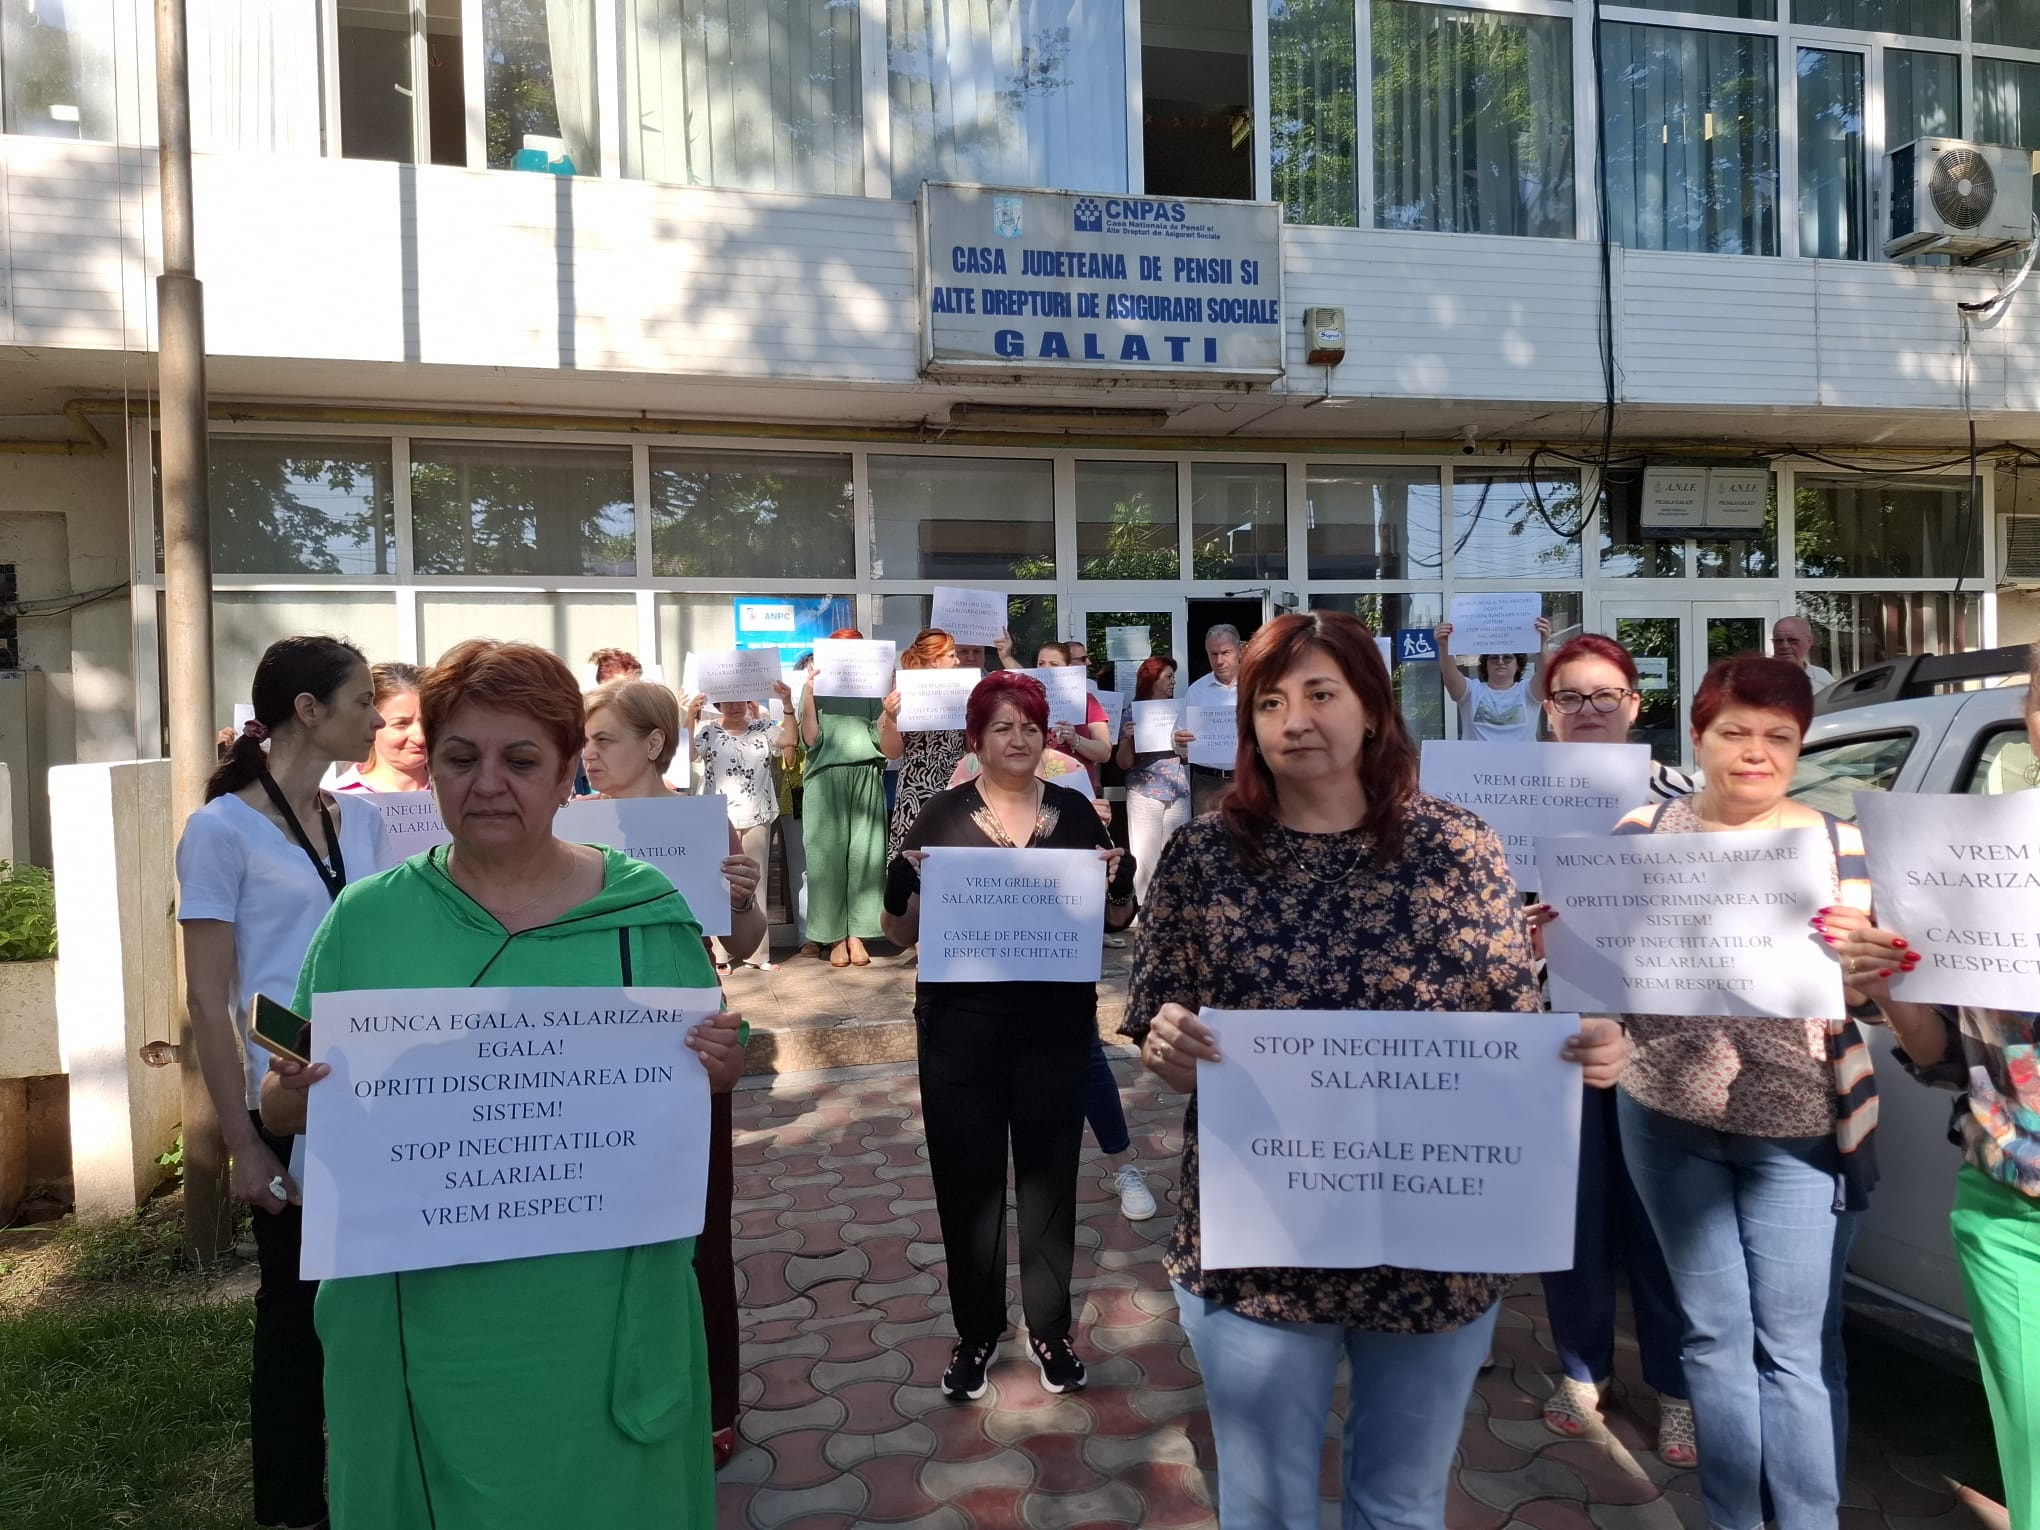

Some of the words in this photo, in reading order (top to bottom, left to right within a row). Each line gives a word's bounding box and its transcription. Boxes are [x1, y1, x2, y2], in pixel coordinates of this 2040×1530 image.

[1105, 200, 1186, 222] CNPAS
[1122, 228, 1150, 236] Drepturi
[1165, 230, 1195, 239] Asigurari
[952, 246, 1007, 276] CASA
[1022, 250, 1128, 280] JUDETEANA
[1140, 255, 1162, 282] DE
[1174, 258, 1232, 285] PENSII
[1241, 260, 1258, 286] SI
[932, 288, 975, 314] ALTE
[983, 289, 1071, 318] DREPTURI
[1078, 293, 1099, 319] DE
[1106, 294, 1202, 322] ASIGURARI
[1208, 297, 1278, 324] SOCIALE
[994, 330, 1217, 362] GALATI
[1473, 774, 1516, 786] VREM
[1520, 776, 1565, 788] GRILE
[1570, 777, 1590, 788] DE
[1445, 792, 1538, 806] SALARIZARE
[1542, 795, 1619, 808] CORECTE!
[1508, 835, 1528, 846] DE
[1515, 855, 1527, 864] SI
[1556, 854, 1616, 867] MUNCA
[1621, 853, 1682, 866] EGALA,
[1687, 848, 1799, 864] SALARIZARE
[1948, 844, 2029, 860] VREM
[966, 878, 1000, 888] VREM
[1005, 878, 1040, 888] GRILE
[1044, 878, 1060, 888] DE
[1643, 872, 1707, 885] EGALA!
[942, 894, 1018, 905] SALARIZARE
[1022, 895, 1082, 906] CORECTE!
[1566, 895, 1618, 908] OPRITI
[1623, 893, 1760, 907] DISCRIMINAREA
[1765, 893, 1797, 905] DIN
[1647, 914, 1712, 926] SISTEM!
[944, 931, 990, 941] CASELE
[994, 931, 1010, 941] DE
[1013, 931, 1050, 941] PENSII
[1054, 931, 1079, 942] CER
[1596, 936, 1636, 948] STOP
[1641, 936, 1774, 949] INECHITATILOR
[1926, 928, 2028, 947] CASELE
[944, 948, 997, 958] RESPECT
[1000, 948, 1010, 958] SI
[1014, 948, 1078, 959] ECHITATE!
[1635, 956, 1735, 969] SALARIALE!
[1622, 977, 1670, 990] VREM
[1676, 979, 1754, 991] RESPECT!
[350, 1015, 441, 1033] MUNCA
[450, 1013, 536, 1031] EGALA,
[543, 1008, 684, 1026] SALARIZARE
[477, 1039, 564, 1058] EGALA!
[1253, 1036, 1315, 1056] STOP
[1323, 1038, 1520, 1060] INECHITATILOR
[354, 1077, 435, 1098] OPRITI
[442, 1068, 626, 1094] DISCRIMINAREA
[634, 1066, 673, 1084] DIN
[1310, 1070, 1459, 1091] SALARIALE!
[472, 1101, 562, 1122] SISTEM!
[390, 1141, 450, 1162] STOP
[458, 1130, 637, 1158] INECHITATILOR
[1251, 1138, 1325, 1159] GRILE
[1333, 1140, 1414, 1161] EGALE
[1423, 1143, 1522, 1165] PENTRU
[445, 1163, 583, 1189] SALARIALE!
[1287, 1171, 1384, 1192] FUNCTII
[1392, 1174, 1484, 1196] EGALE!
[421, 1204, 490, 1226] VREM
[497, 1194, 603, 1219] RESPECT!
